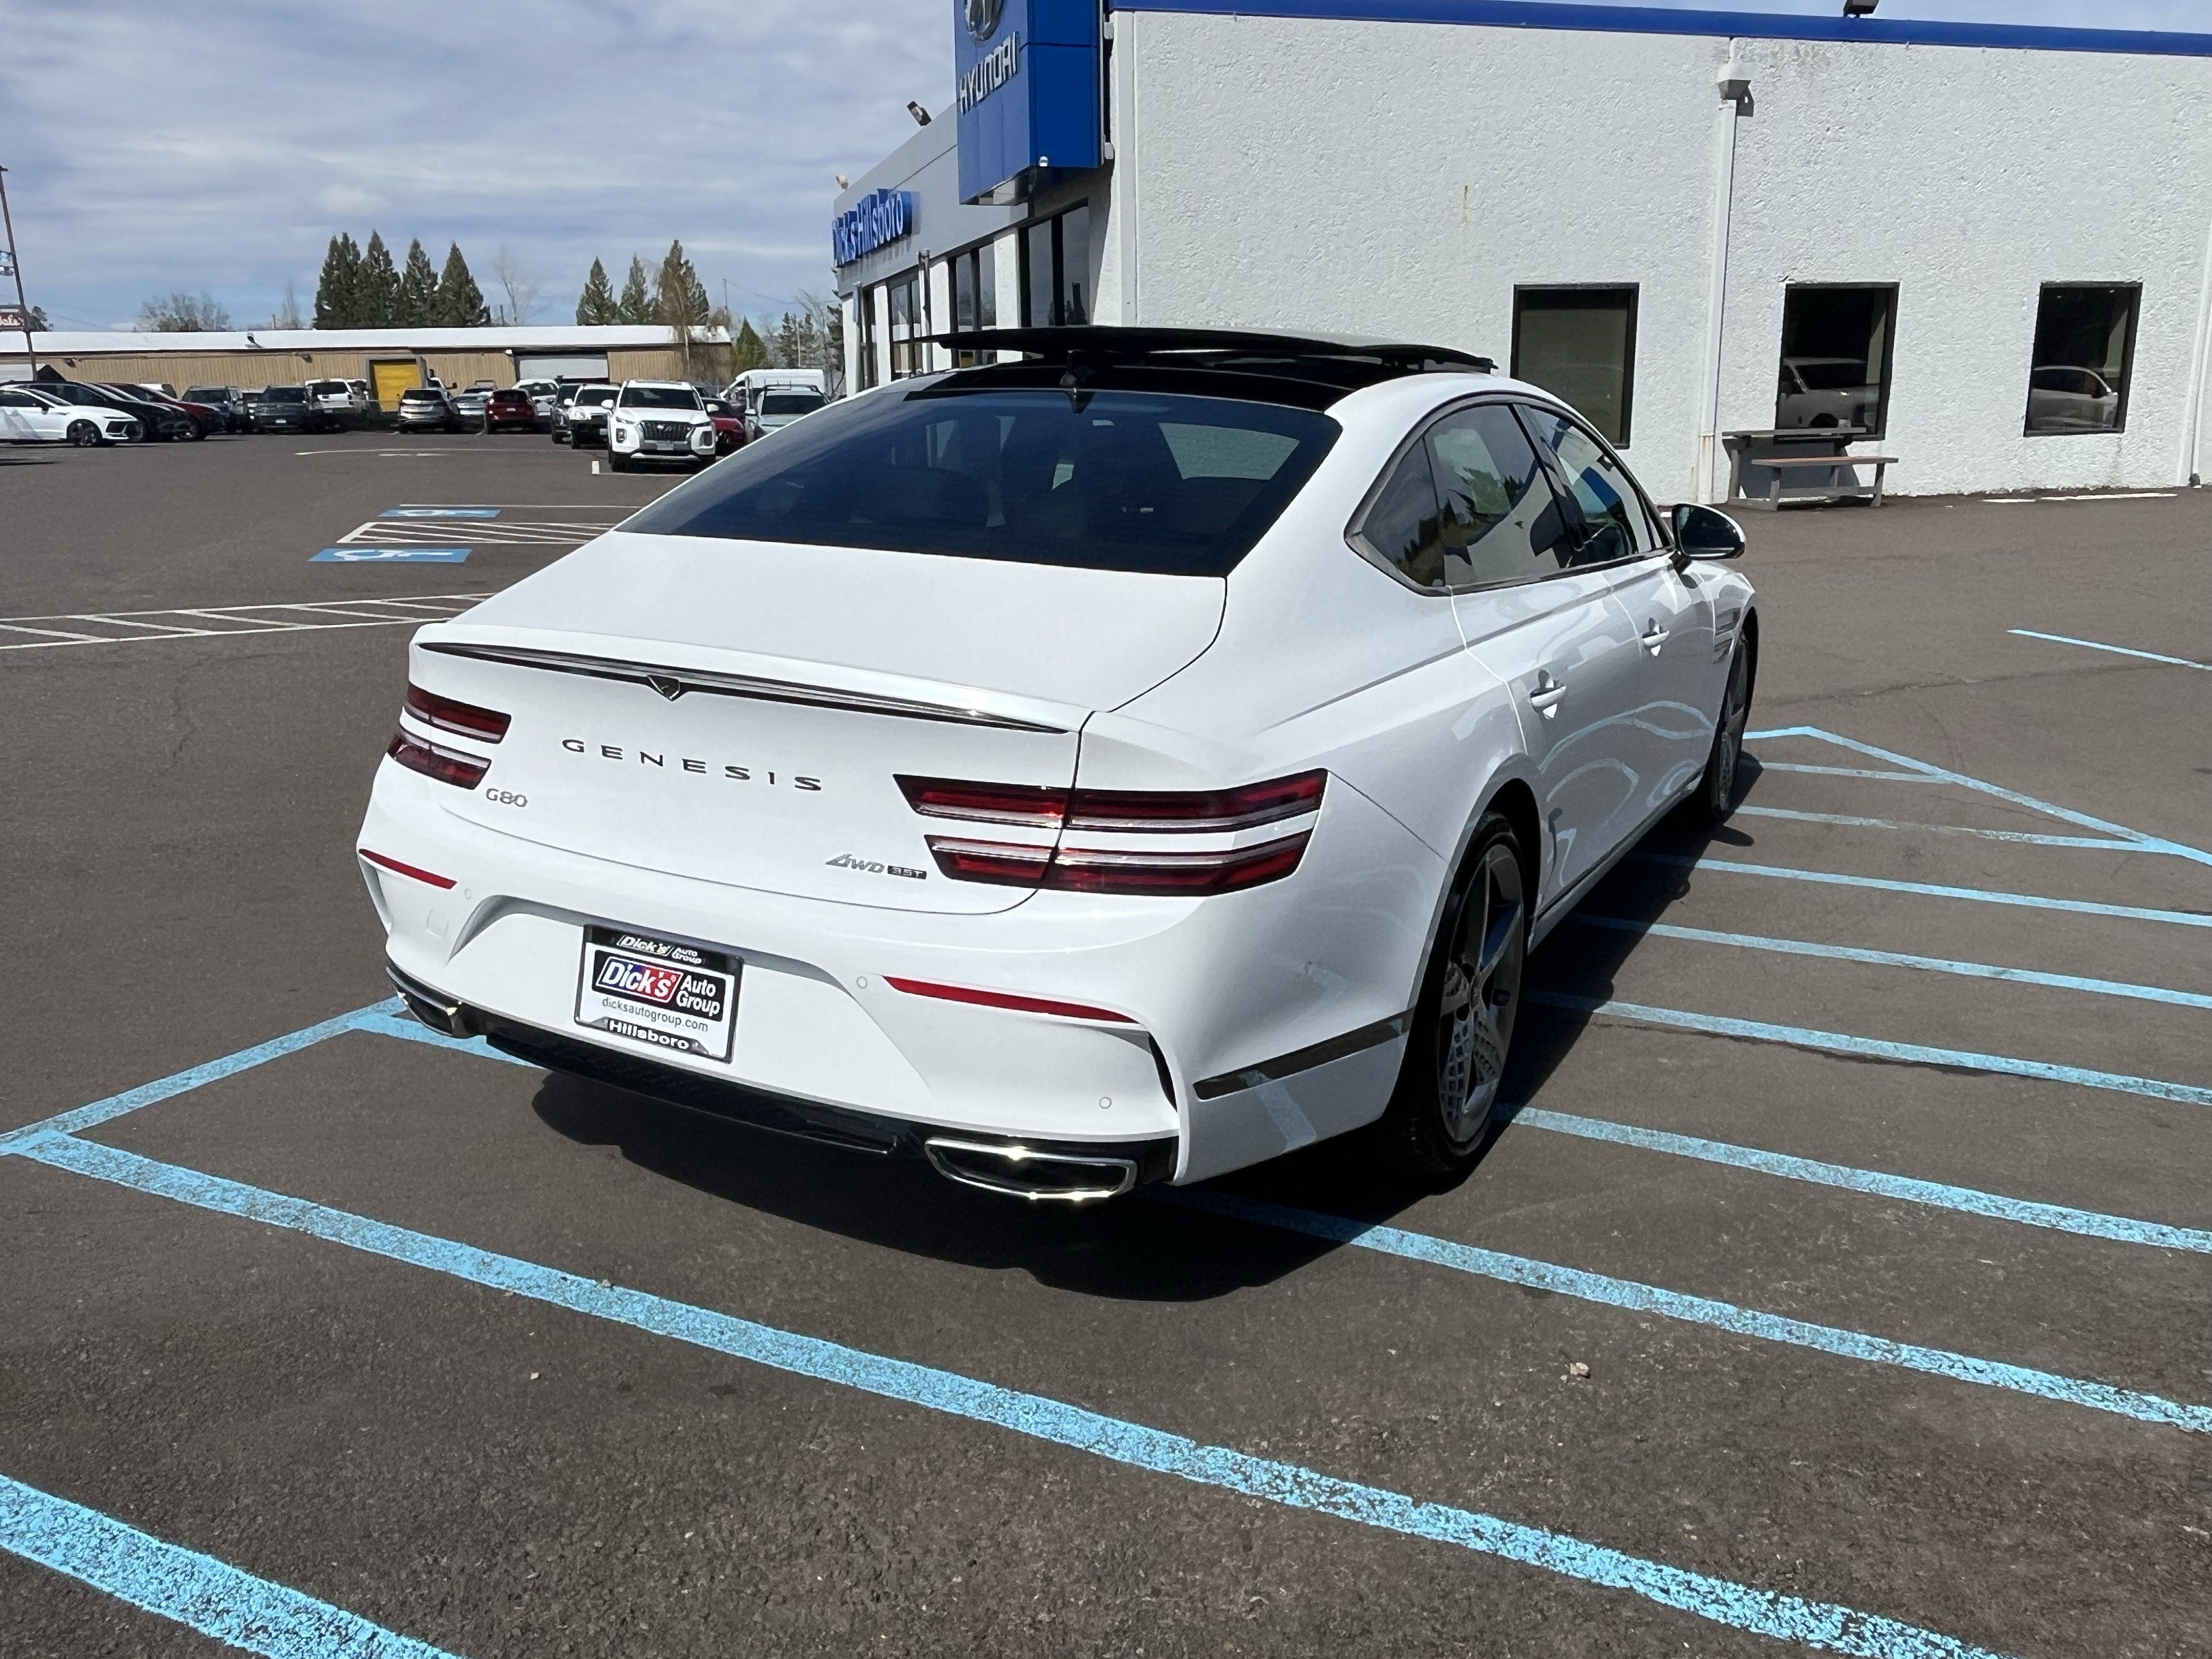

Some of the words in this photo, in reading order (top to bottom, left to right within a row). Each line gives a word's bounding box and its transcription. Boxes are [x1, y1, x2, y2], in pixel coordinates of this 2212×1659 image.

[958, 31, 1019, 115] HYUNDAI
[561, 738, 822, 791] GENESIS
[486, 788, 528, 808] G80
[825, 854, 884, 873] AWD
[621, 935, 671, 955] Dick's
[602, 961, 676, 997] Dick's
[680, 975, 716, 997] Auto
[602, 997, 708, 1032] dicksautogroup.com
[676, 991, 720, 1017] Group
[609, 1020, 690, 1049] Hillsboro
